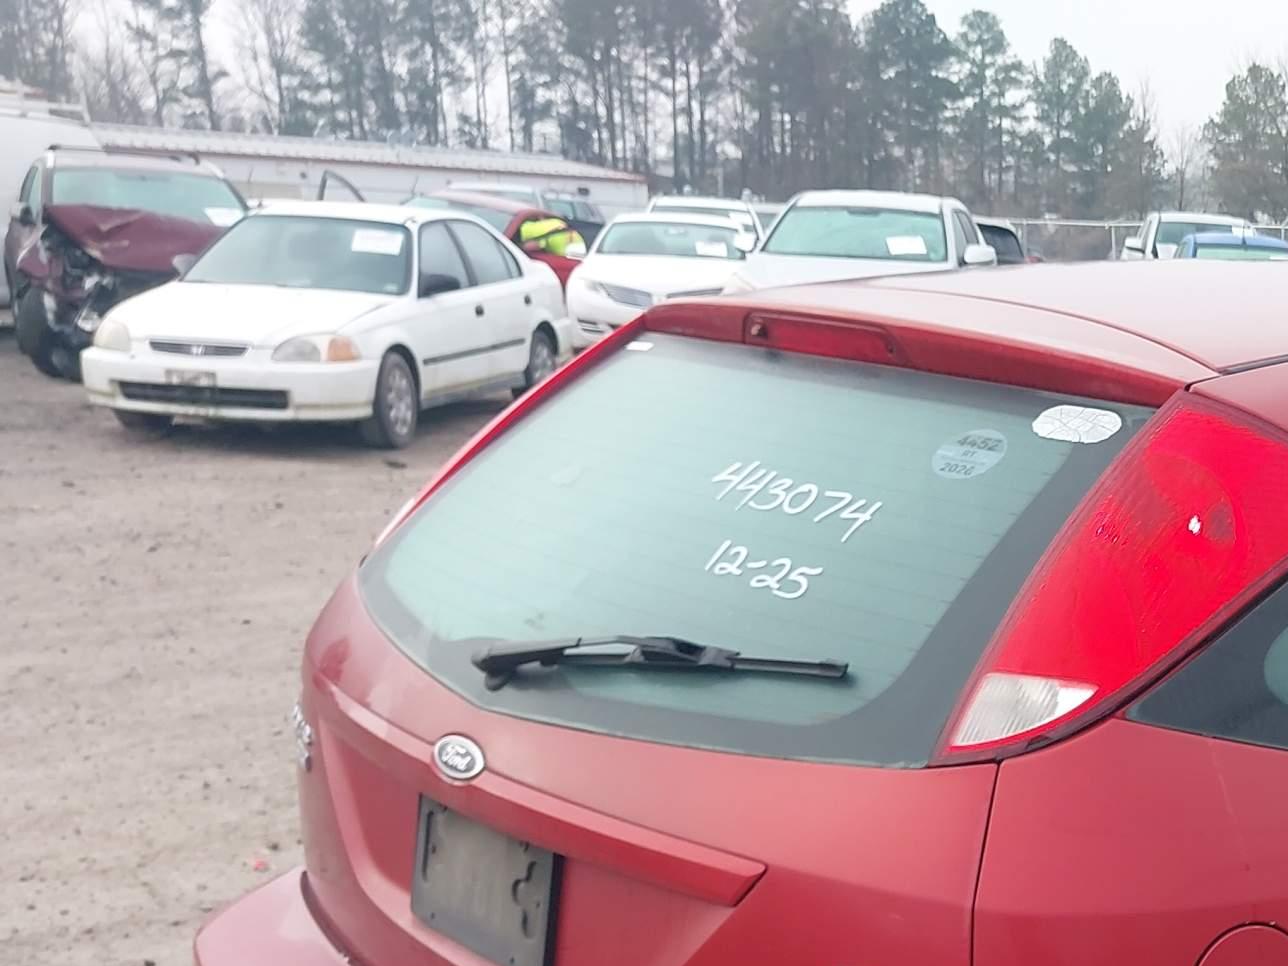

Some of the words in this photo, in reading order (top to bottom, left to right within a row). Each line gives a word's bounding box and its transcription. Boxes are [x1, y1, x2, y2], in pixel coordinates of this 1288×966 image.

[711, 461, 883, 543] 443074
[705, 539, 824, 599] 12-25
[441, 743, 472, 771] Ford
